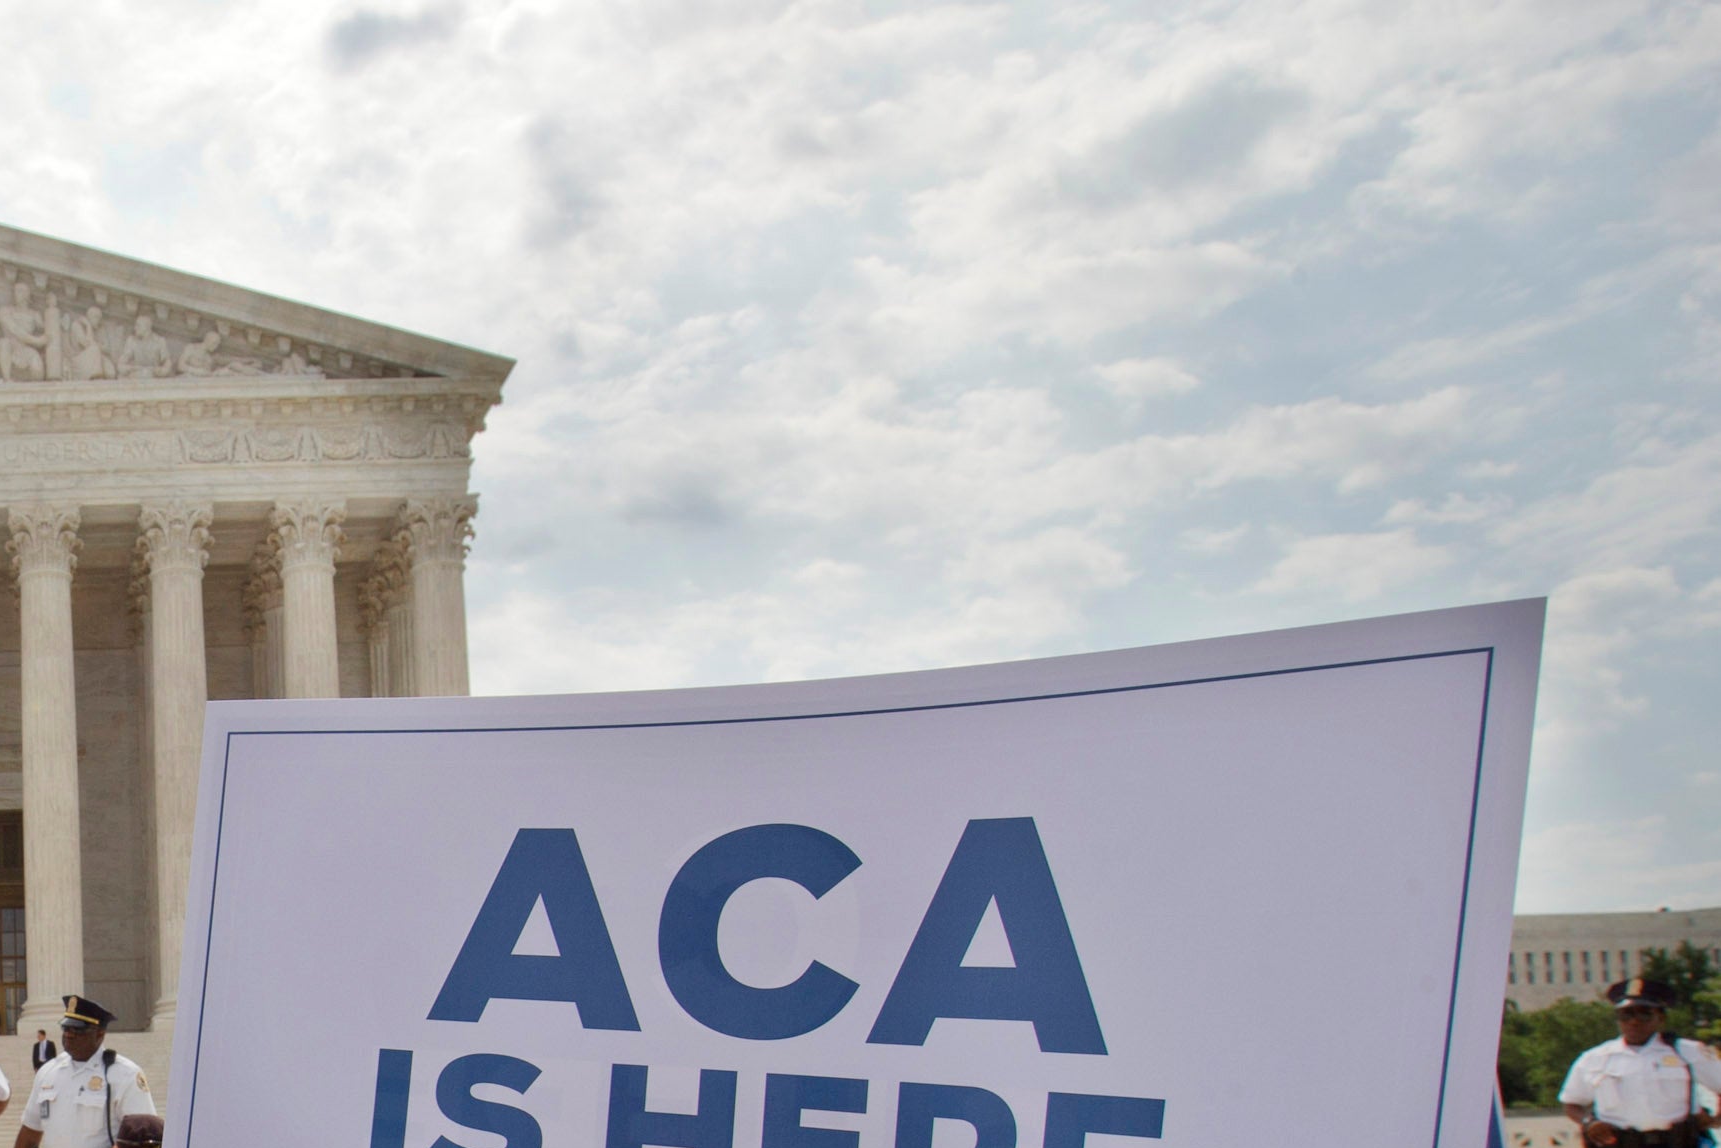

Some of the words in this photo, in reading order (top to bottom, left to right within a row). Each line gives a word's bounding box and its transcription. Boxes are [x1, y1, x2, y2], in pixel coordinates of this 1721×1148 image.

[4, 440, 93, 464] UNDER
[104, 438, 157, 461] LAW
[426, 816, 1109, 1056] ACA
